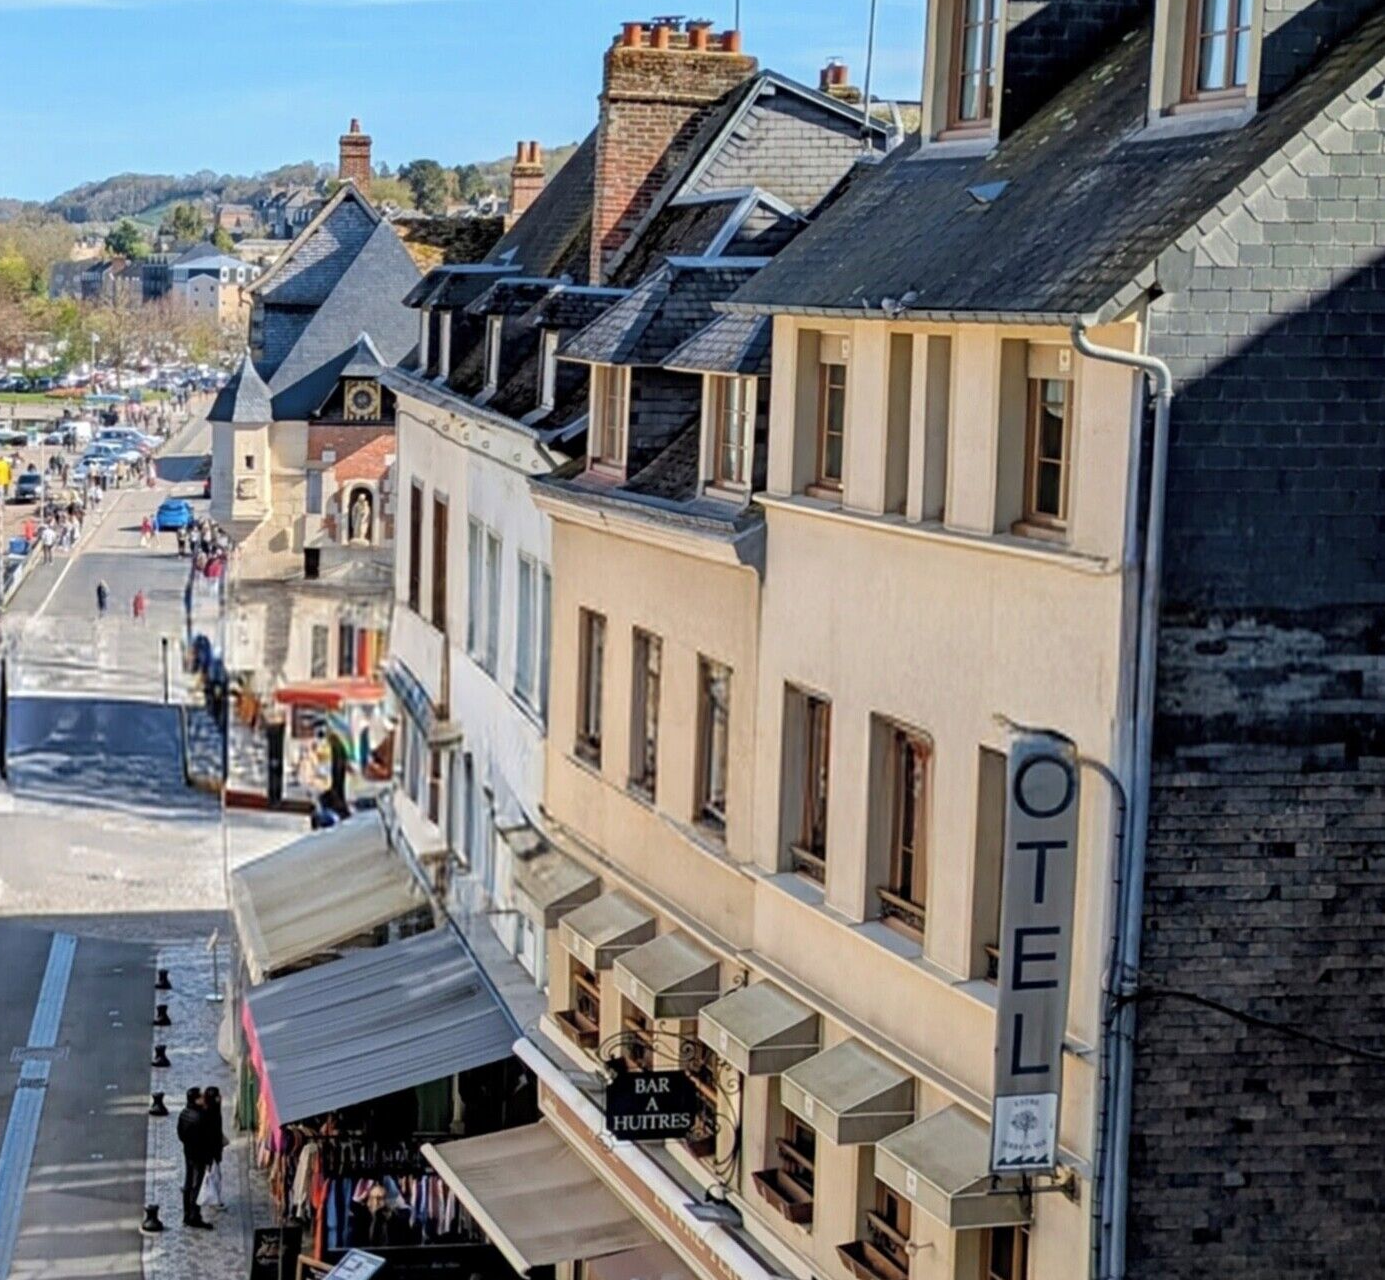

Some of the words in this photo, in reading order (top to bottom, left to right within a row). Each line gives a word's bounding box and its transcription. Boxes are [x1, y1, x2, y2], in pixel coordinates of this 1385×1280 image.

[635, 1077, 670, 1094] BAR
[645, 1096, 659, 1112] A
[614, 1112, 691, 1131] HUITRES
